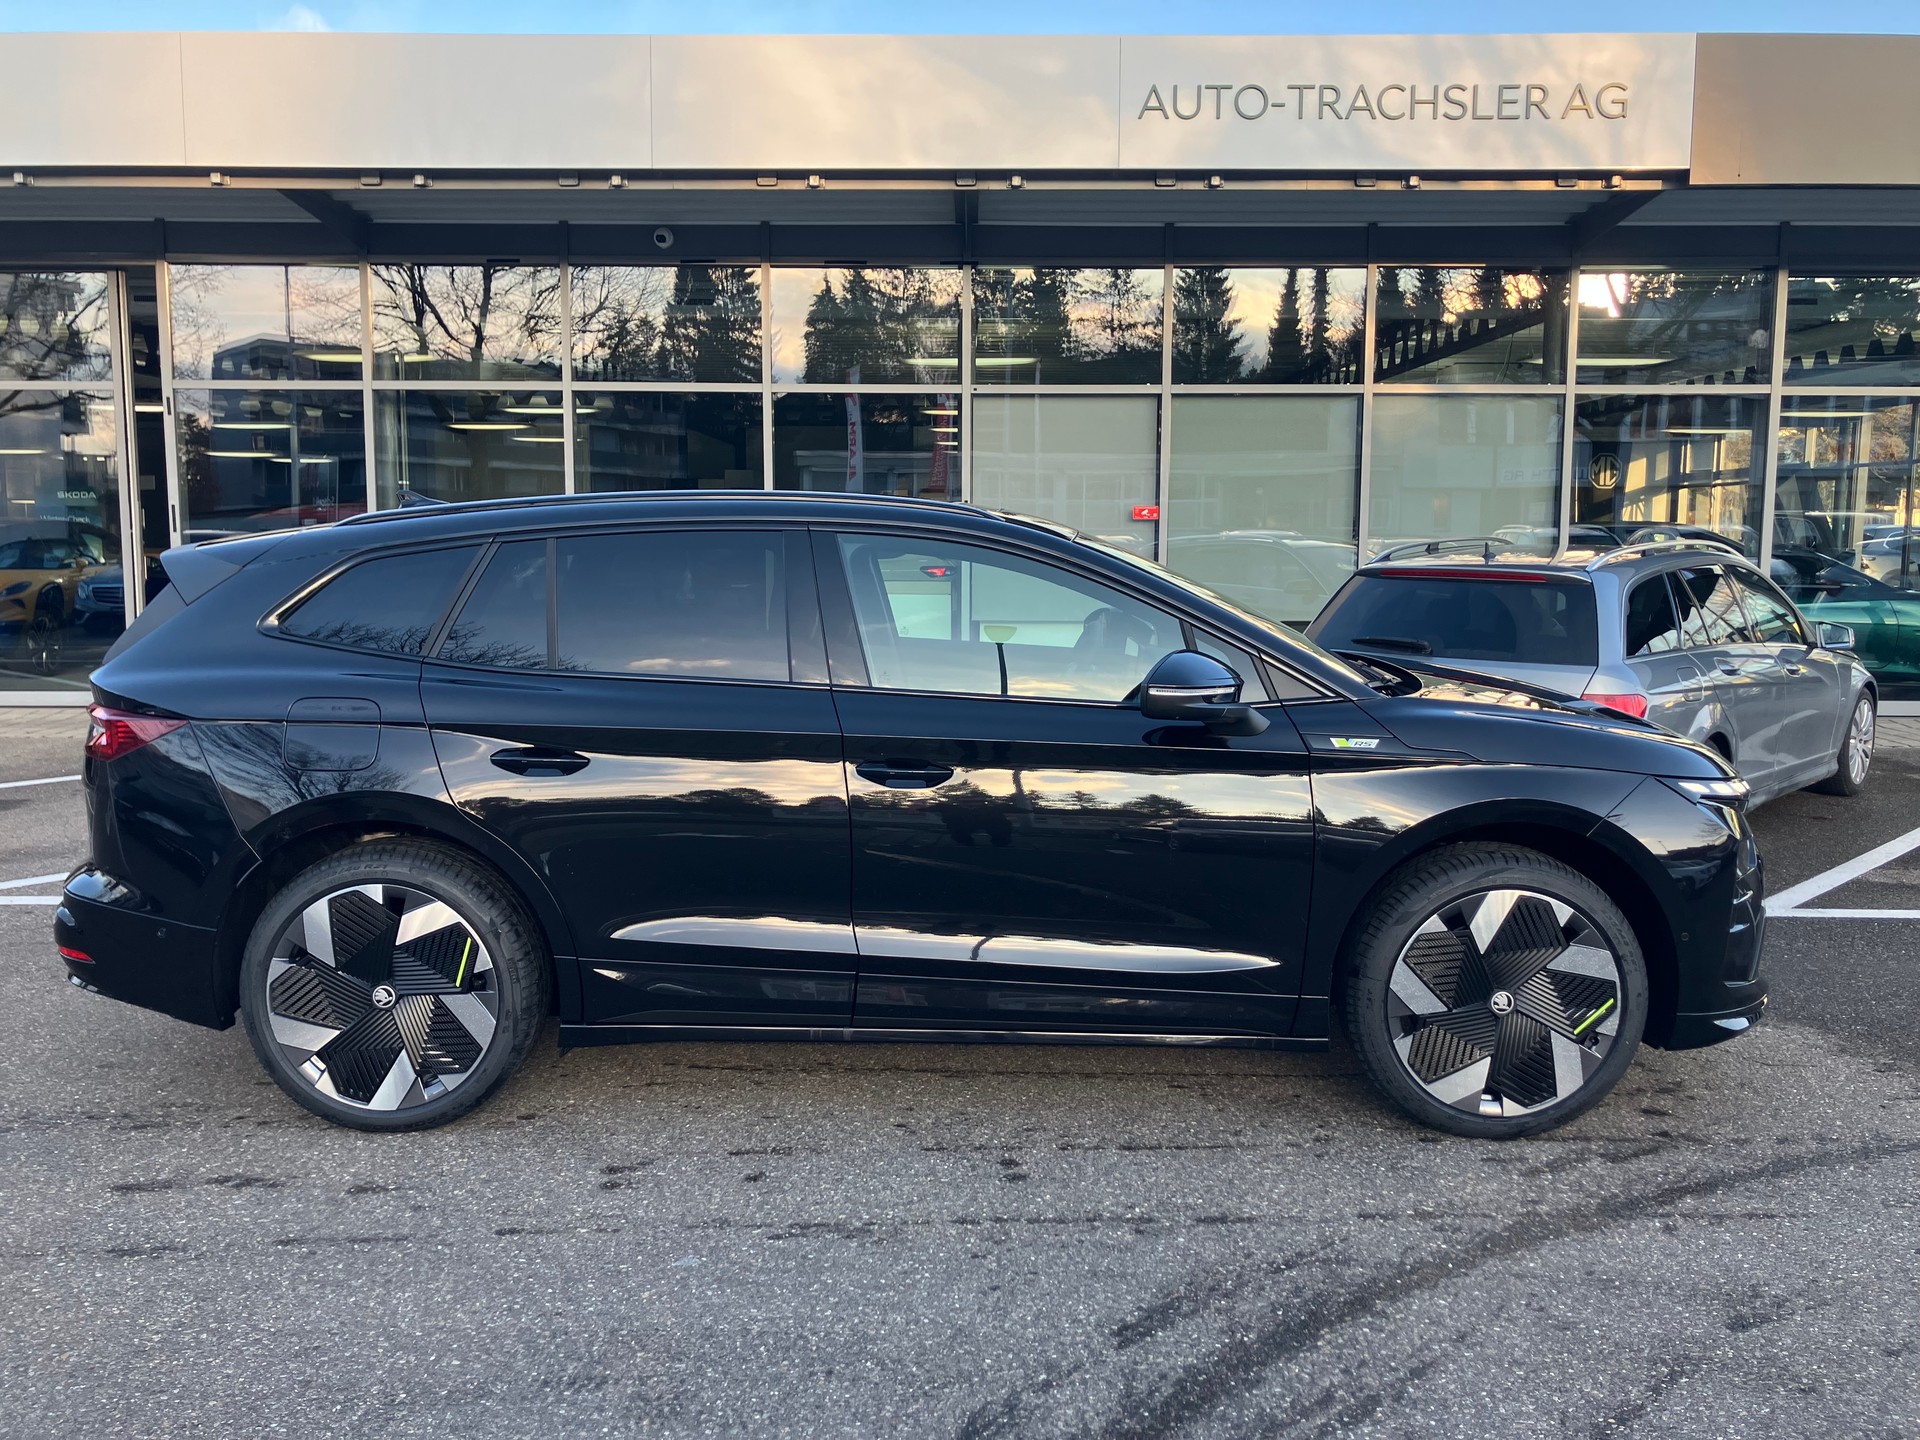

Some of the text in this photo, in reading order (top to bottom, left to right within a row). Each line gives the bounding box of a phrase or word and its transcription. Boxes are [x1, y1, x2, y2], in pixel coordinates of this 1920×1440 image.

[1137, 83, 1629, 121] AUTO-TRACHSLER AG
[1591, 456, 1621, 487] MG
